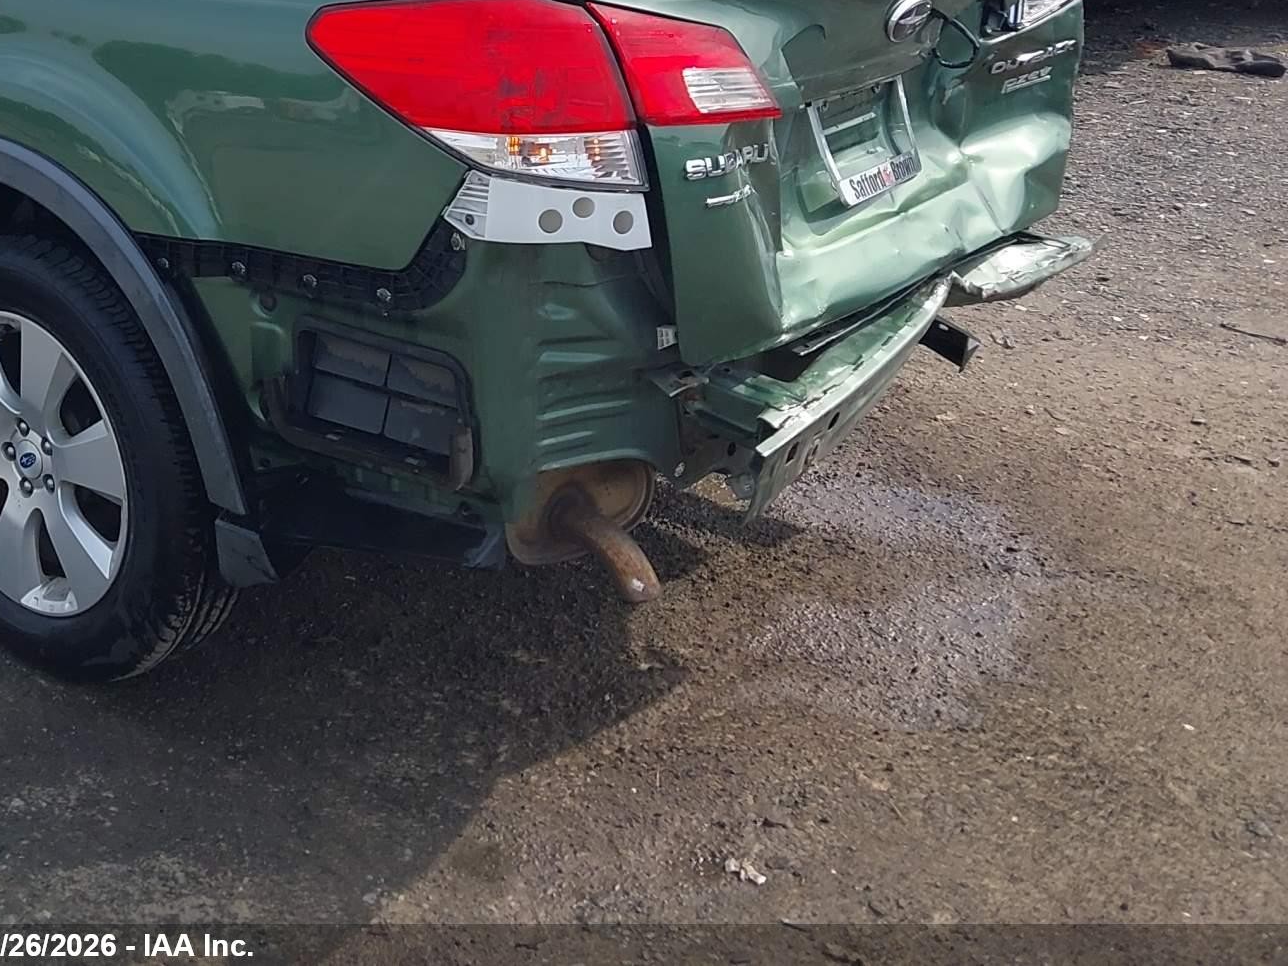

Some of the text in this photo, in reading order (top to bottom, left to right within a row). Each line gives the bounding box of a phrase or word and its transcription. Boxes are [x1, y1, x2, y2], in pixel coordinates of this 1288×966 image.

[685, 142, 770, 181] SUBARU
[848, 155, 917, 200] Safford Brown
